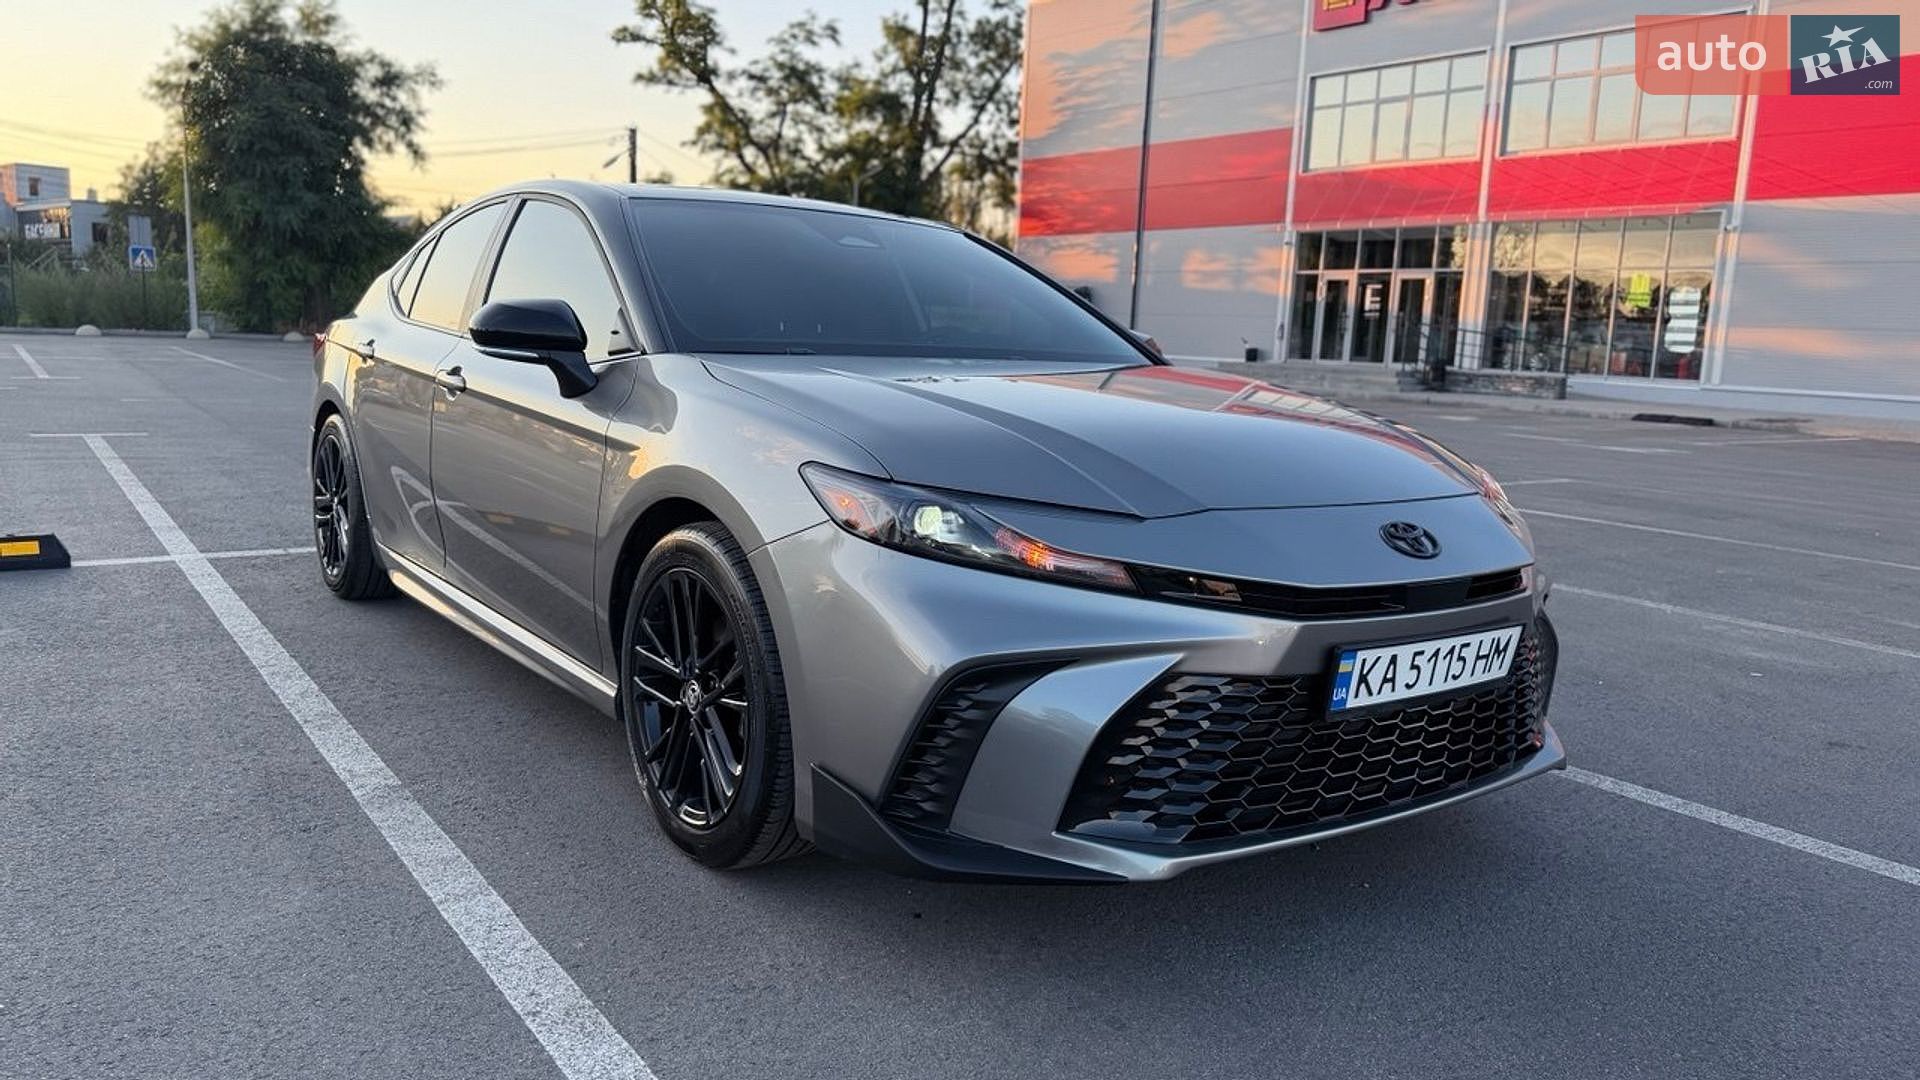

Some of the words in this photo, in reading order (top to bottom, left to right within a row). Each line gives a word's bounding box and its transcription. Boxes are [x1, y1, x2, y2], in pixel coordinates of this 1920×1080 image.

[1353, 654, 1398, 699] KA
[1404, 642, 1471, 690] 5115
[1470, 634, 1513, 677] HM
[1332, 686, 1347, 701] UA
